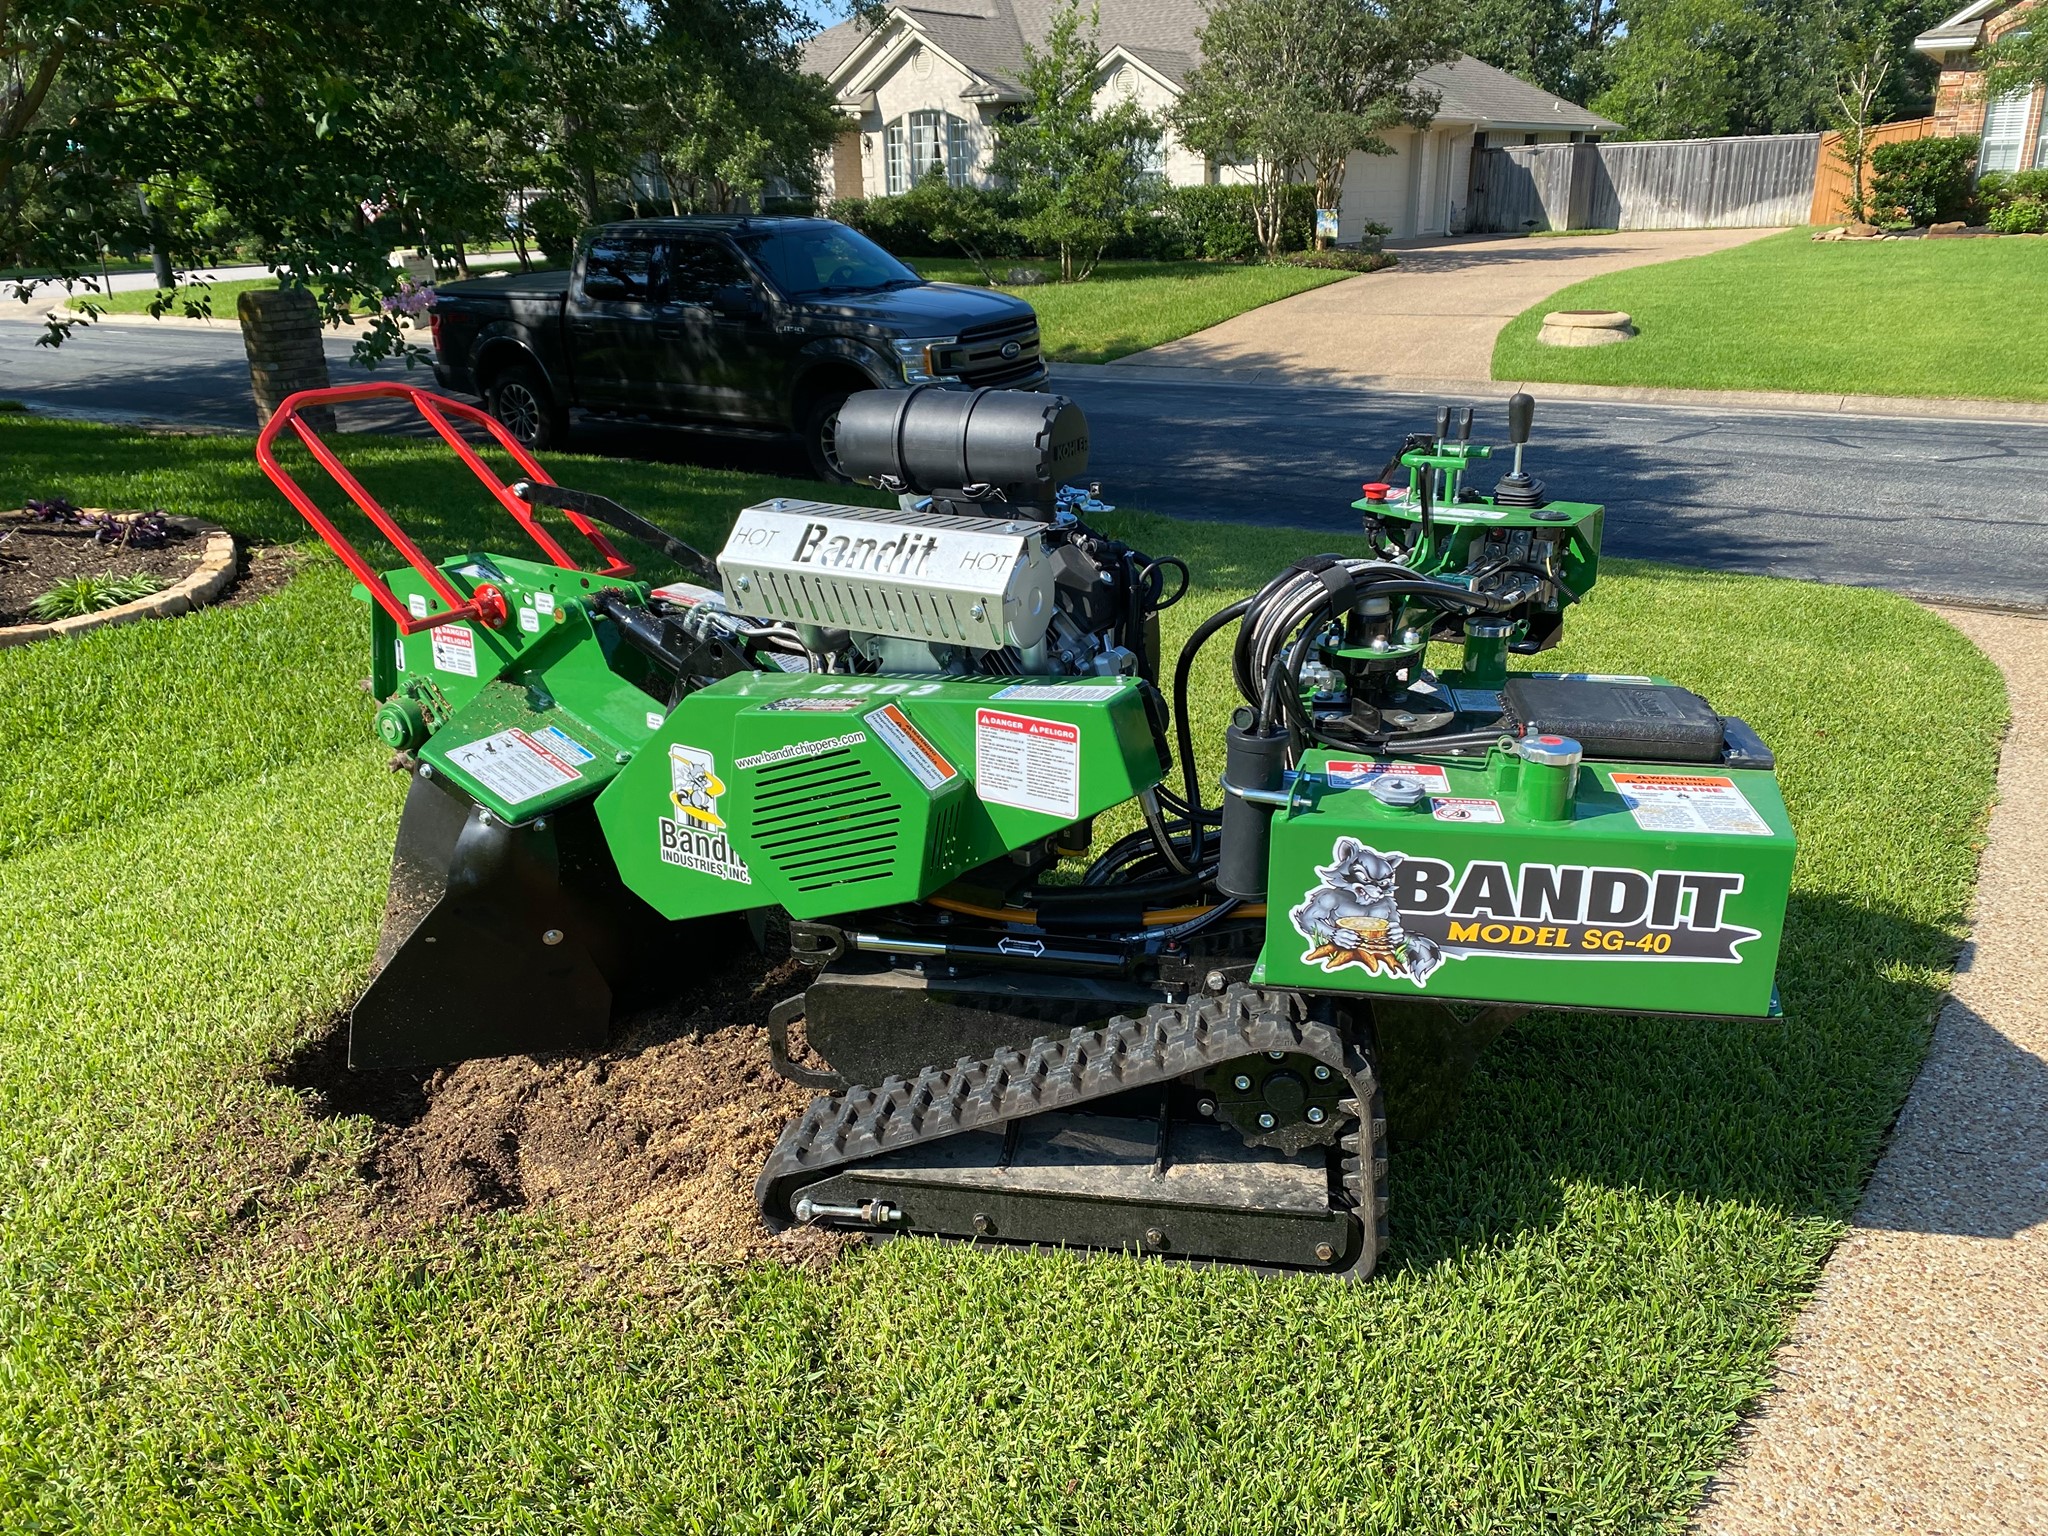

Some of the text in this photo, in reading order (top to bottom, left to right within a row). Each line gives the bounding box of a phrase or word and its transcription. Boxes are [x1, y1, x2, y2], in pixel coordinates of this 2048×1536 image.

[732, 526, 780, 548] HOT
[792, 523, 938, 576] Bandit
[959, 551, 1013, 573] HOT
[441, 626, 469, 638] DANGER
[442, 635, 470, 647] PELIGRO
[990, 717, 1024, 729] DANGER
[1039, 726, 1075, 739] PELIGRO
[736, 732, 865, 768] www.banditchippers.com
[1631, 784, 1725, 794] GASOLINE
[662, 848, 750, 883] INDUSTRIES, INC.
[1397, 860, 1740, 929] BANDIT
[1447, 921, 1672, 954] MODEL SG-40
